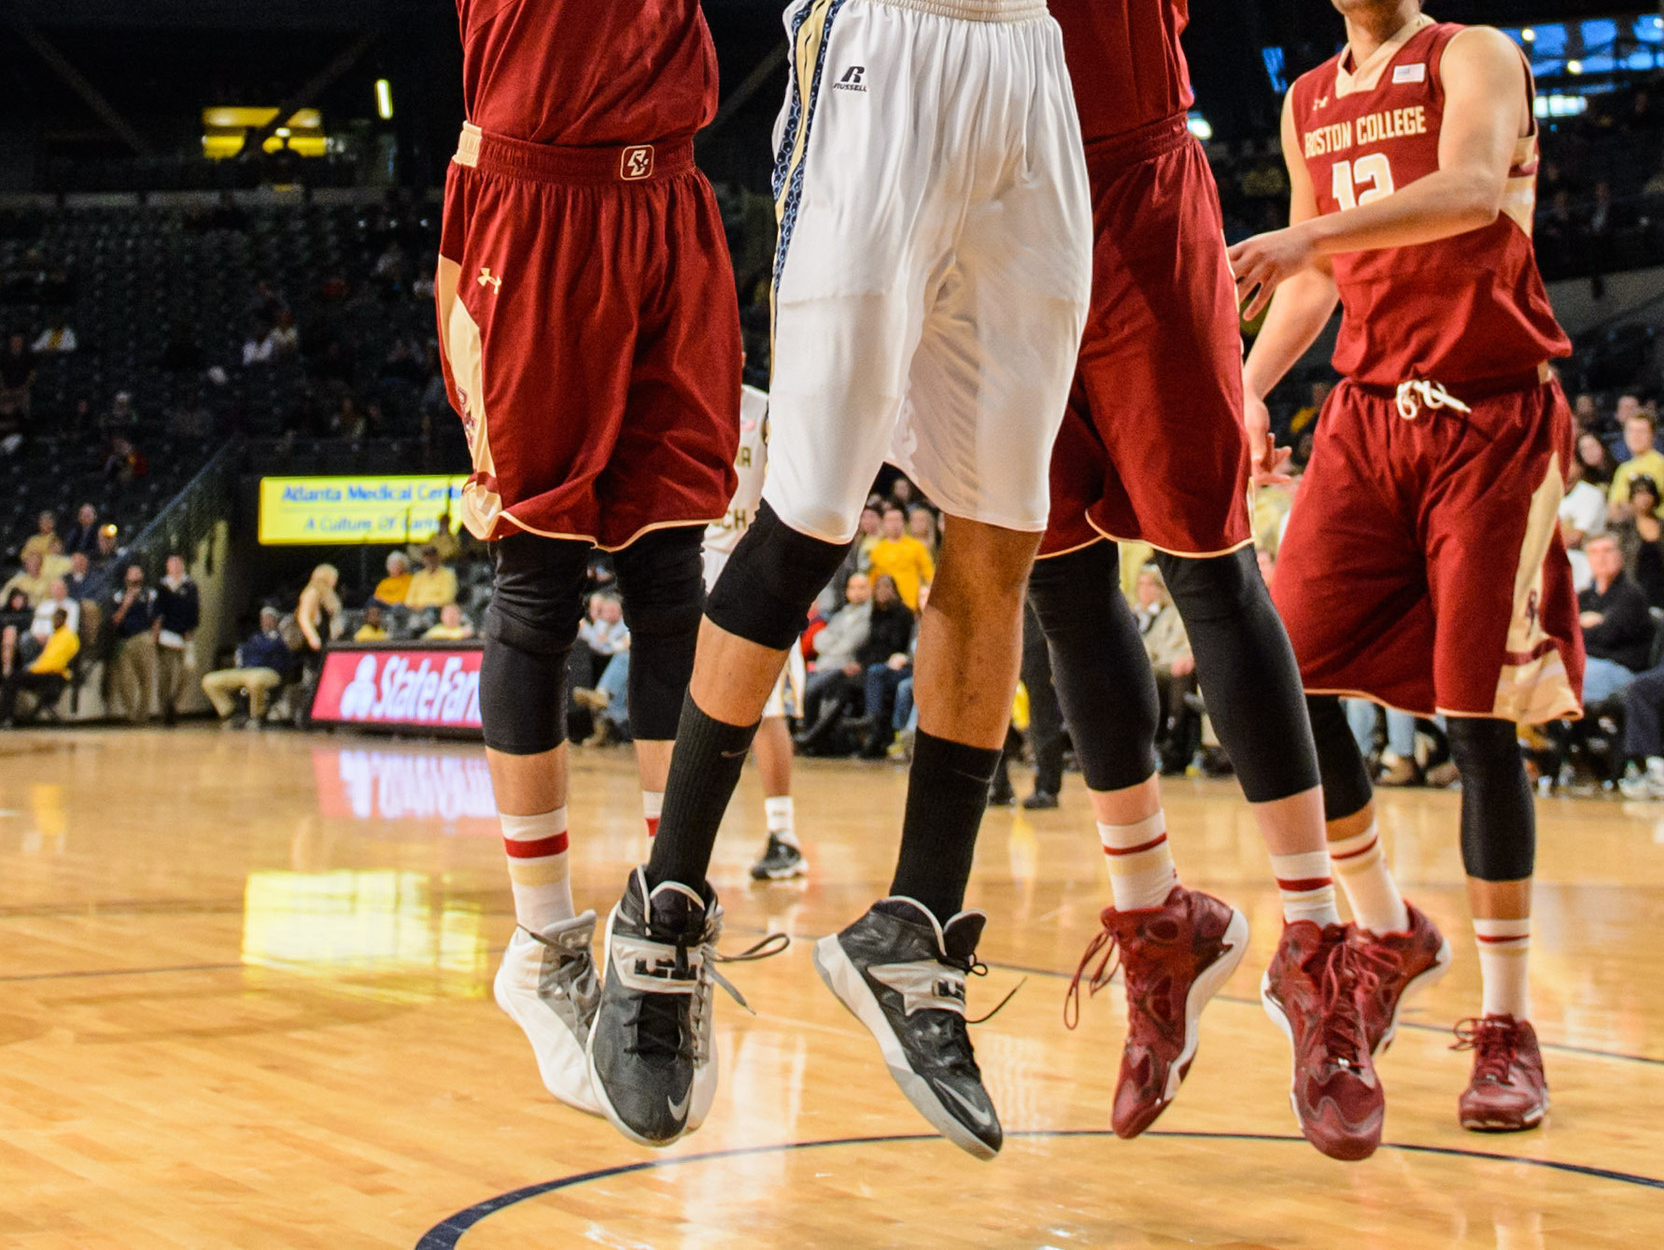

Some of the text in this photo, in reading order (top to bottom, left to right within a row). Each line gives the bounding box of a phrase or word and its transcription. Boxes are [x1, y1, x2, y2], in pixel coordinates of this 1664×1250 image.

[833, 82, 867, 92] RUSSELL
[1355, 105, 1428, 146] COLLEGE
[1331, 152, 1395, 211] 12
[282, 484, 343, 502] Atlanta
[349, 484, 412, 501] Medical
[303, 516, 315, 532] A
[320, 515, 372, 532] Culture
